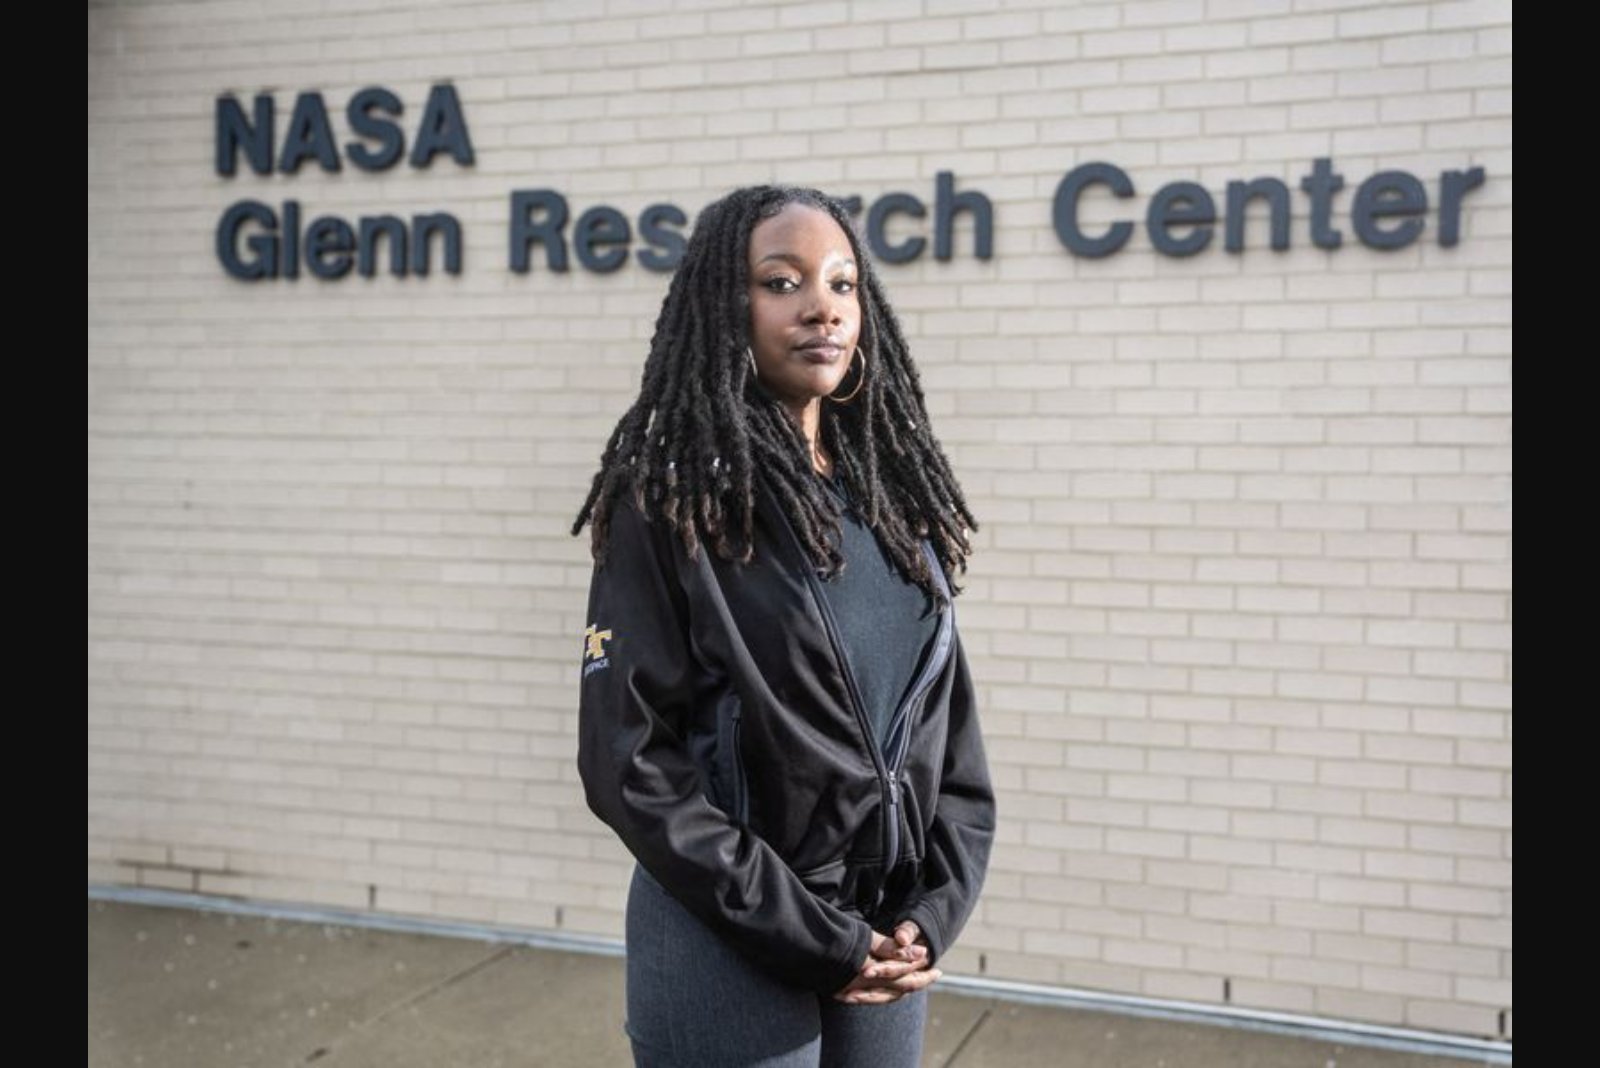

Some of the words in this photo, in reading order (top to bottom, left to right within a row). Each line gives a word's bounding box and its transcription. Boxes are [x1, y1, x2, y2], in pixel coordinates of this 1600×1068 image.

[214, 81, 476, 177] NASA
[215, 199, 463, 281] Glenn
[508, 170, 994, 274] Resch
[1051, 157, 1486, 259] Center
